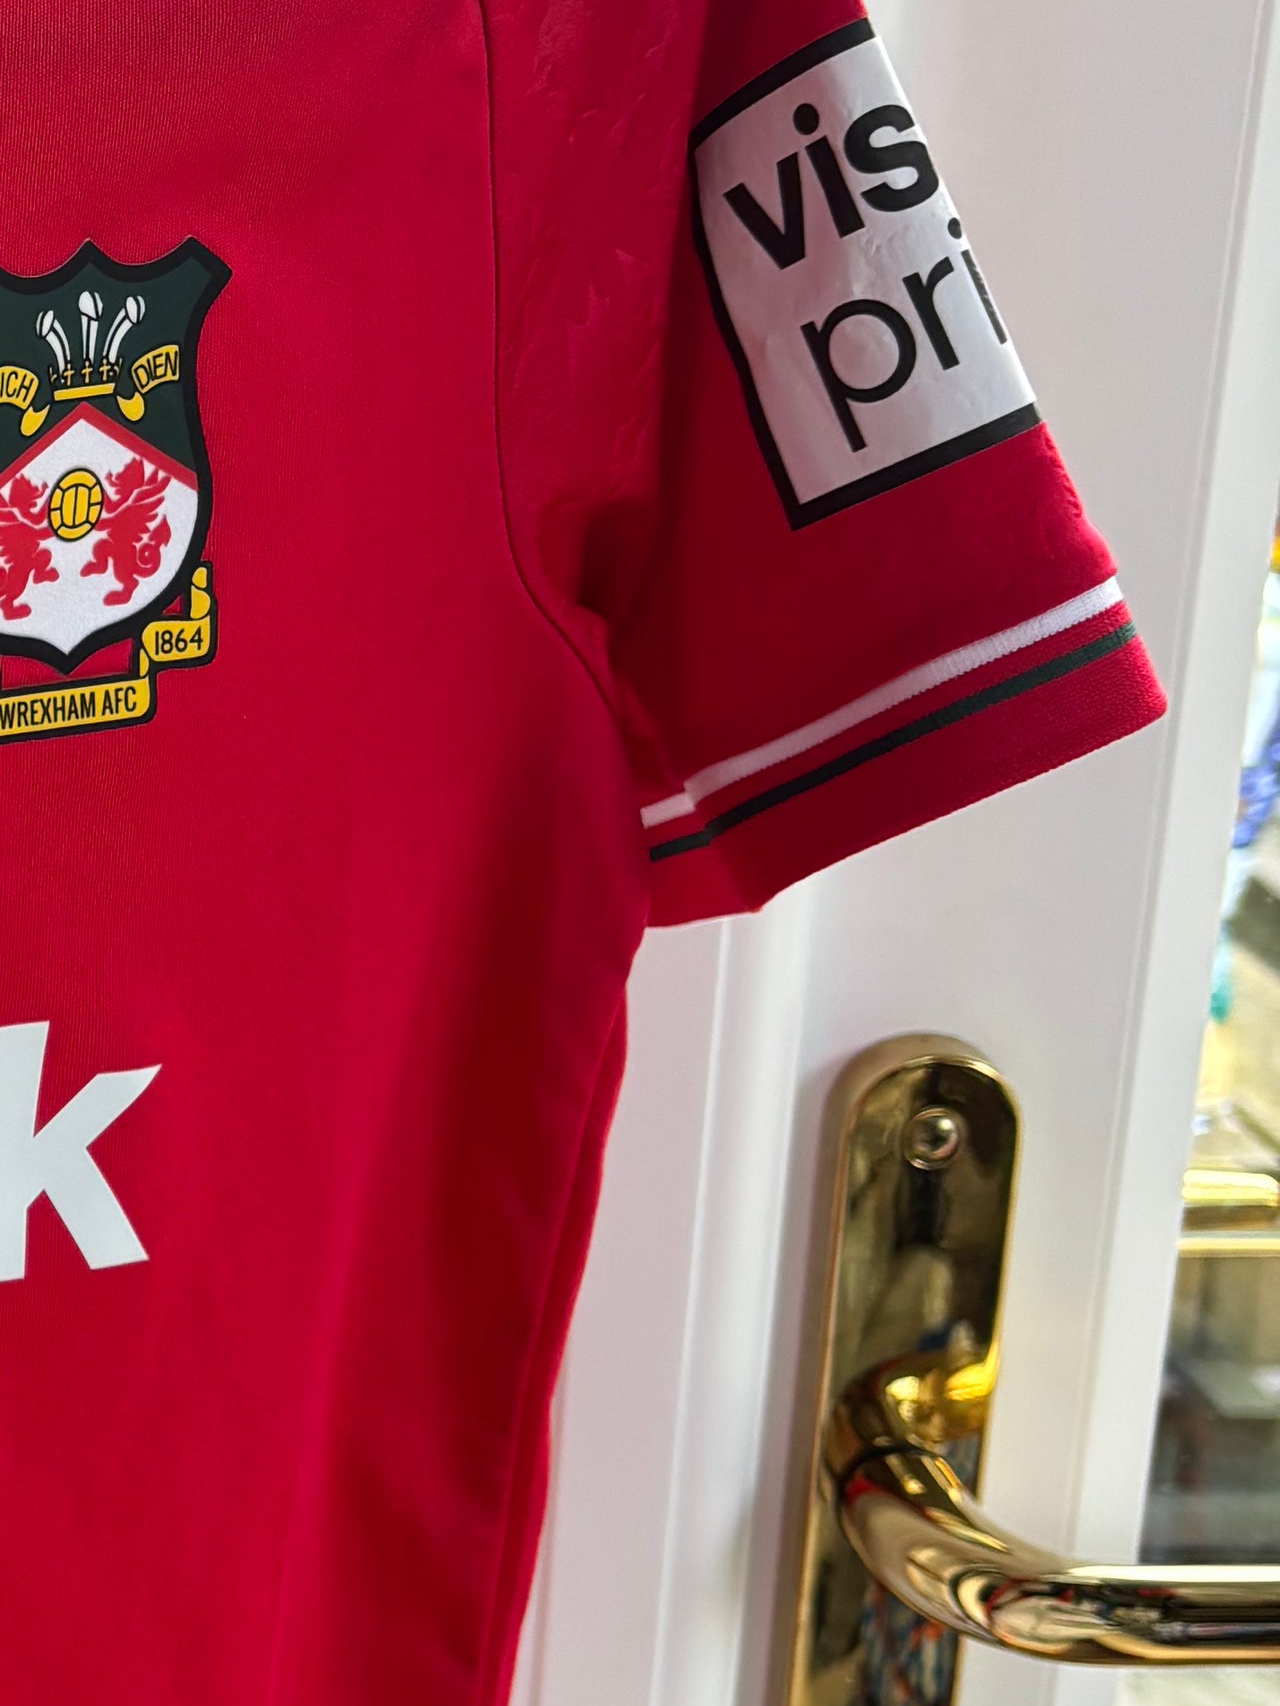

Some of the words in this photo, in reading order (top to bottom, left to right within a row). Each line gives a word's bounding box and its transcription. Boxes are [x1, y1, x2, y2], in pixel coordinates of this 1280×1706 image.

[0, 368, 33, 402] ICH
[136, 351, 179, 390] DIEN
[154, 627, 203, 656] 1864
[101, 687, 138, 715] AFC
